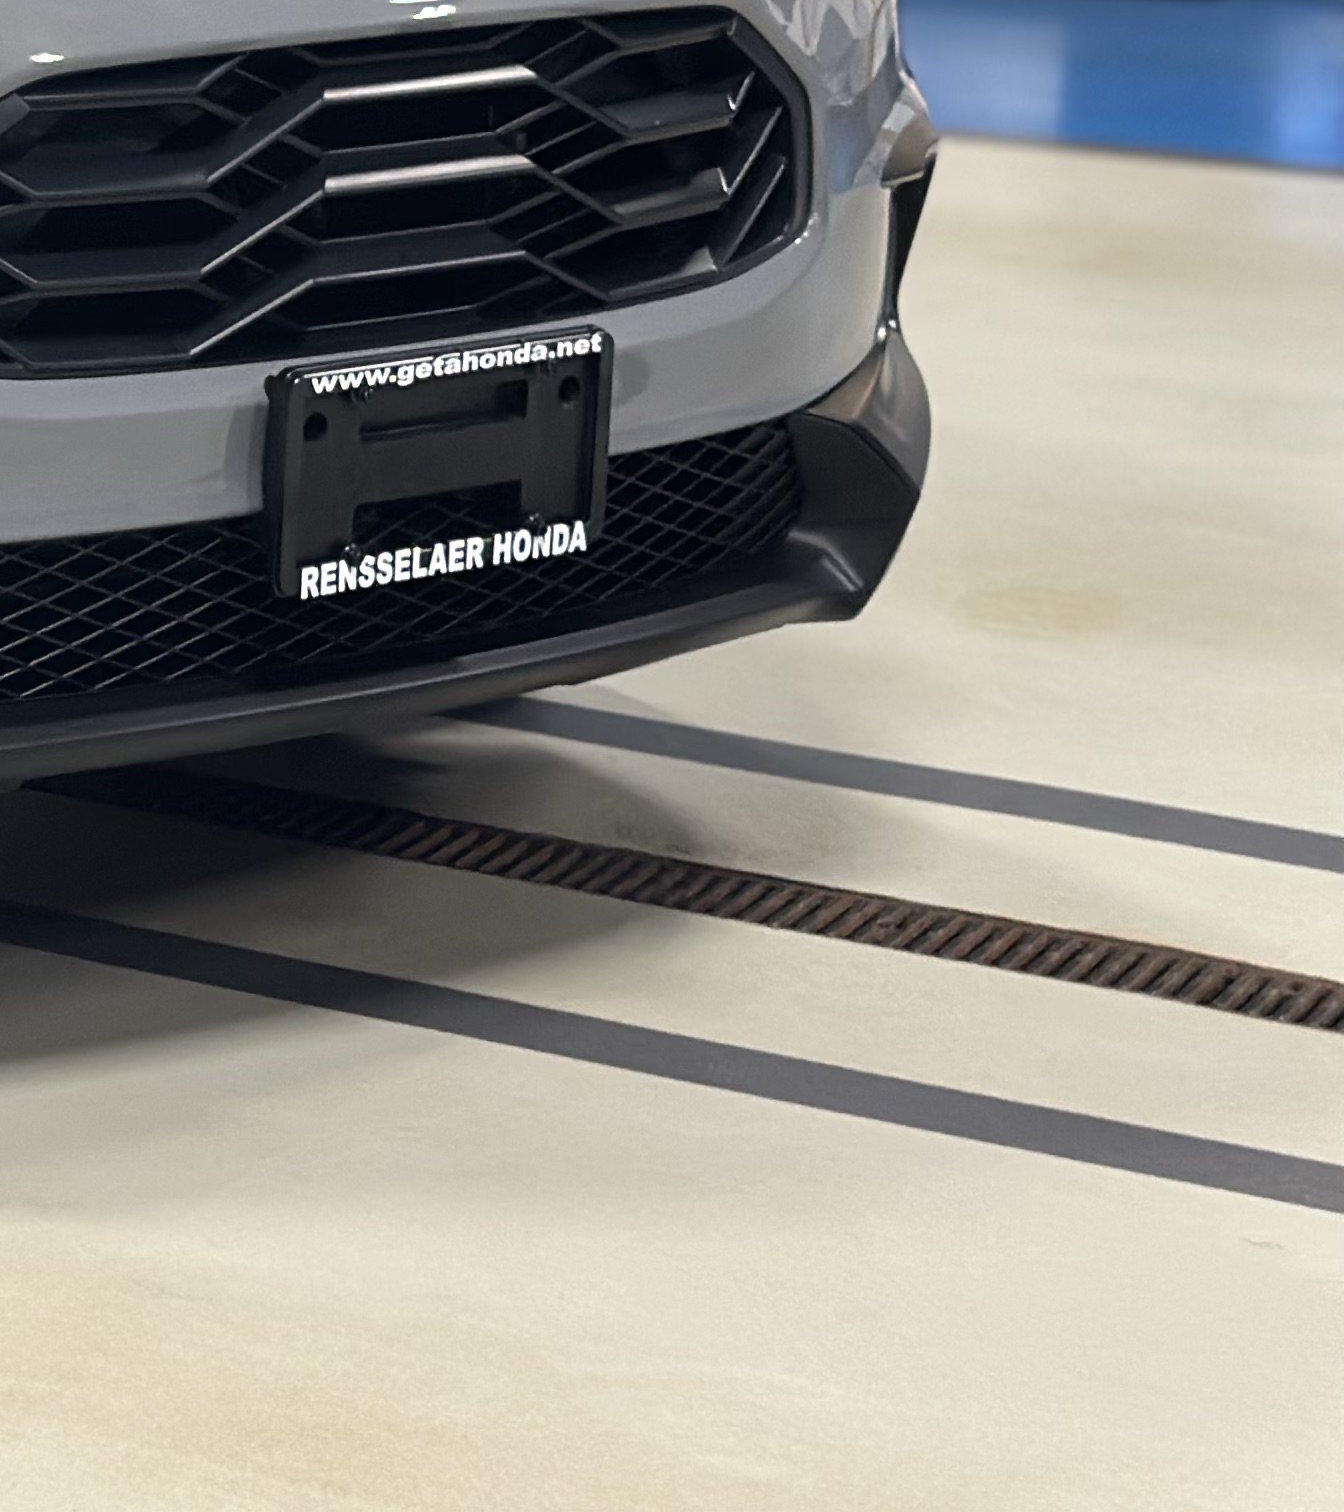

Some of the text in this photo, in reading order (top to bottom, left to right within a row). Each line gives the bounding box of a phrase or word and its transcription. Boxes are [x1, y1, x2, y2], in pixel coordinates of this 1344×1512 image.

[312, 332, 603, 394] www.getahonda.net
[300, 520, 587, 600] RENSSELAER HONDA
